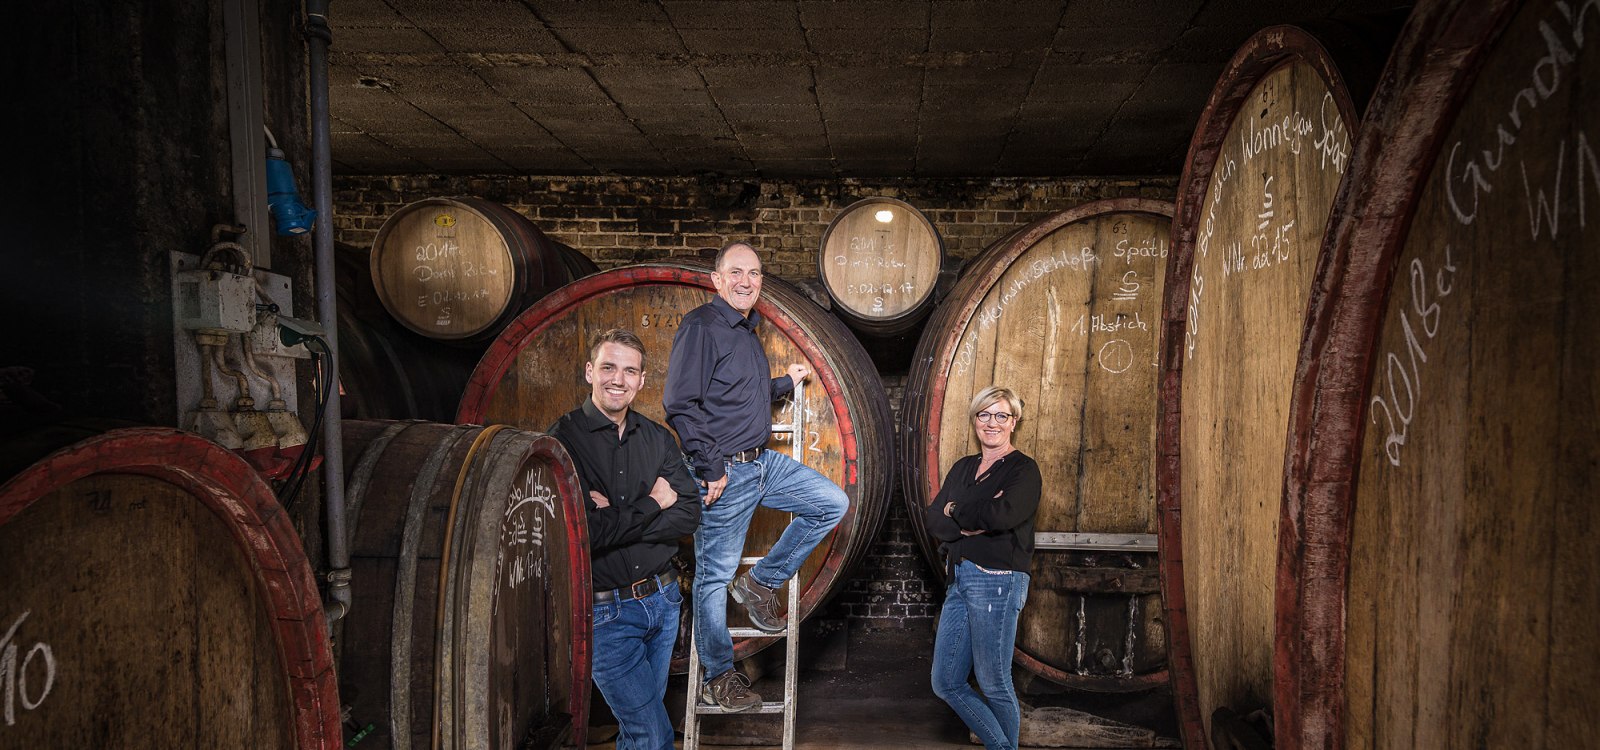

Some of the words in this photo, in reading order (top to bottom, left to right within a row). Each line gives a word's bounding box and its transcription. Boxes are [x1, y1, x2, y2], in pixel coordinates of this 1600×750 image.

[1185, 264, 1205, 360] 2015
[1241, 112, 1314, 166] Wonnegau
[1091, 312, 1148, 334] Abstich
